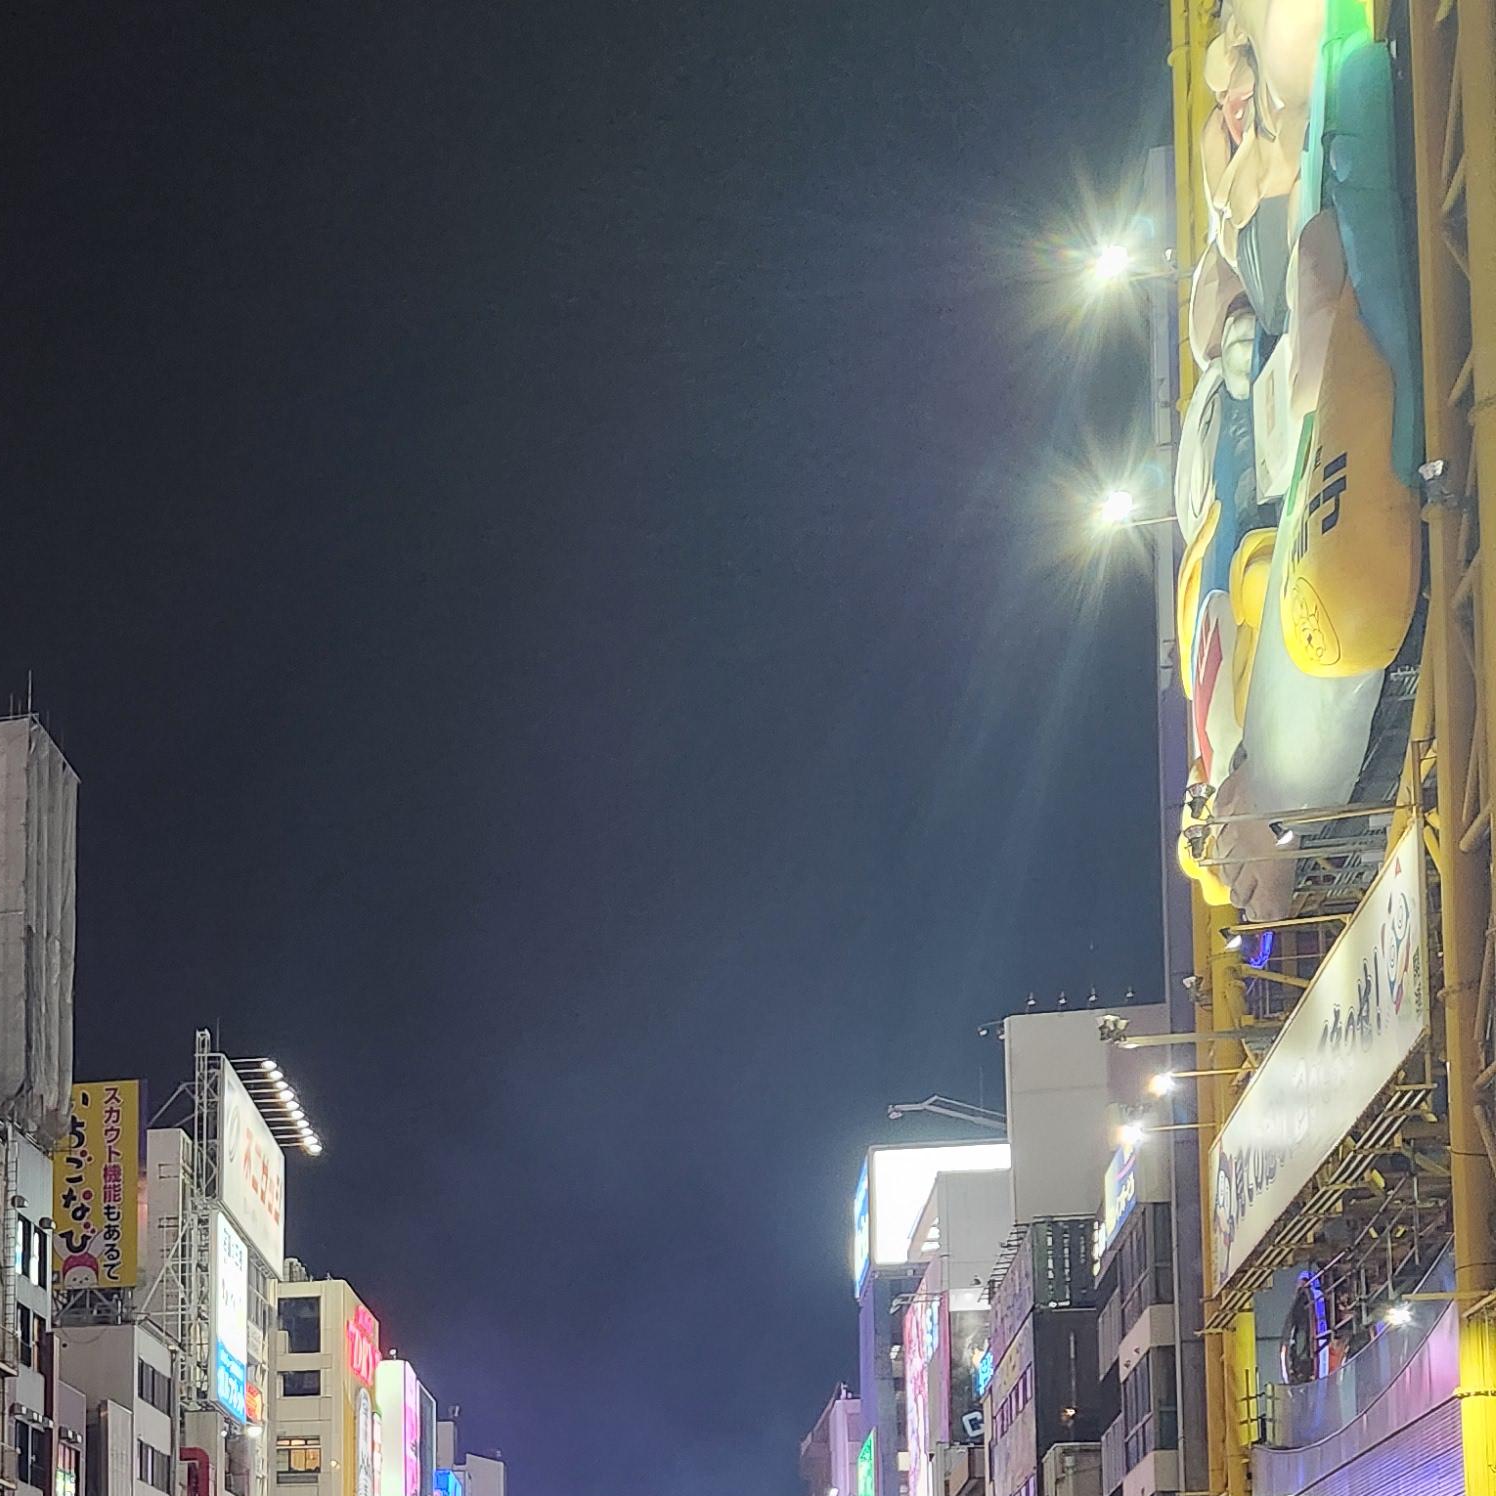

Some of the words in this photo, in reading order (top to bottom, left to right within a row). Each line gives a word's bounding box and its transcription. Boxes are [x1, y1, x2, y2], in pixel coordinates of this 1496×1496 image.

[104, 1087, 122, 1281] スカウト機能もあるで
